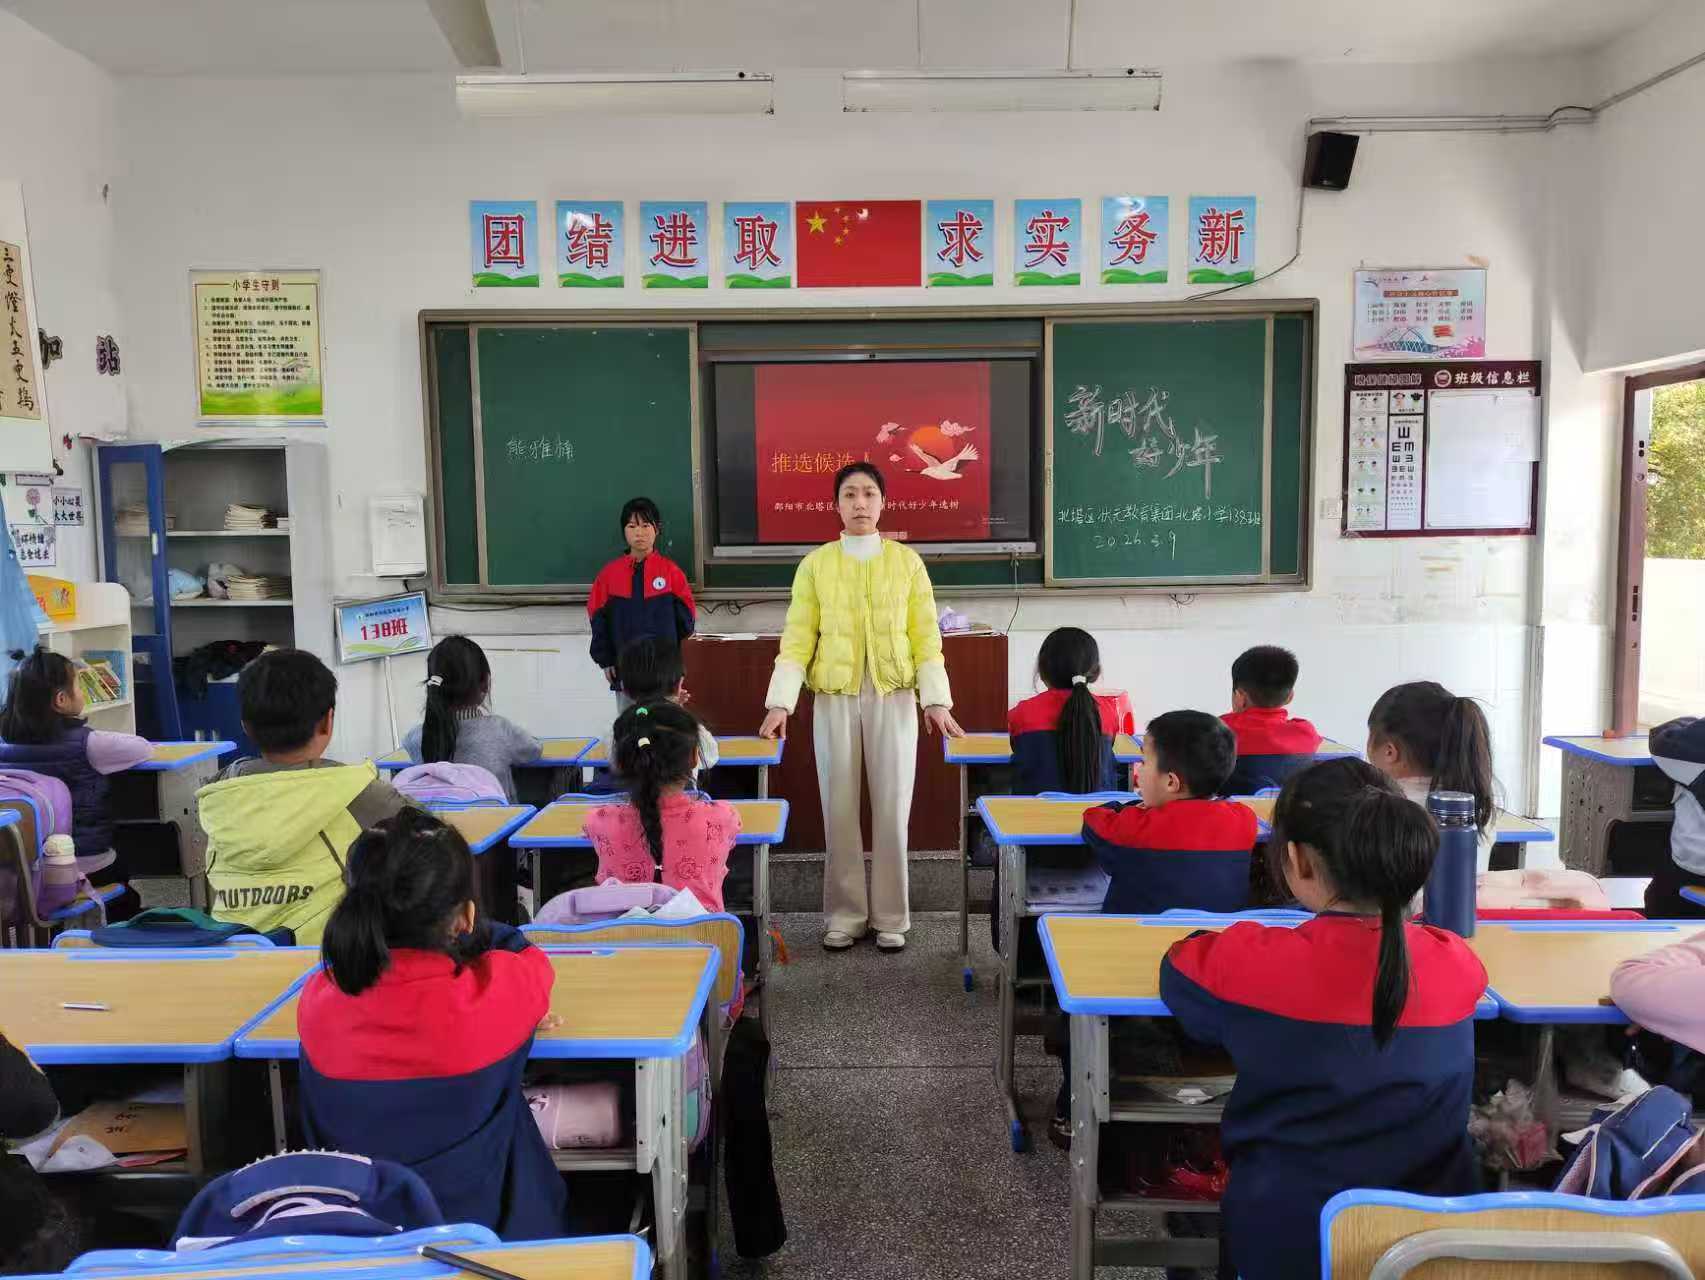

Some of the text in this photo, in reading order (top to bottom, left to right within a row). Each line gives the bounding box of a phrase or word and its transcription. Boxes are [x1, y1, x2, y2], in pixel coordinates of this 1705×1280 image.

[483, 206, 1245, 272] 团结进取 求实务新
[232, 279, 280, 292] 小学生守则
[1454, 370, 1532, 386] 班级信息栏
[1064, 384, 1172, 456] 新时代
[360, 617, 409, 641] 138班
